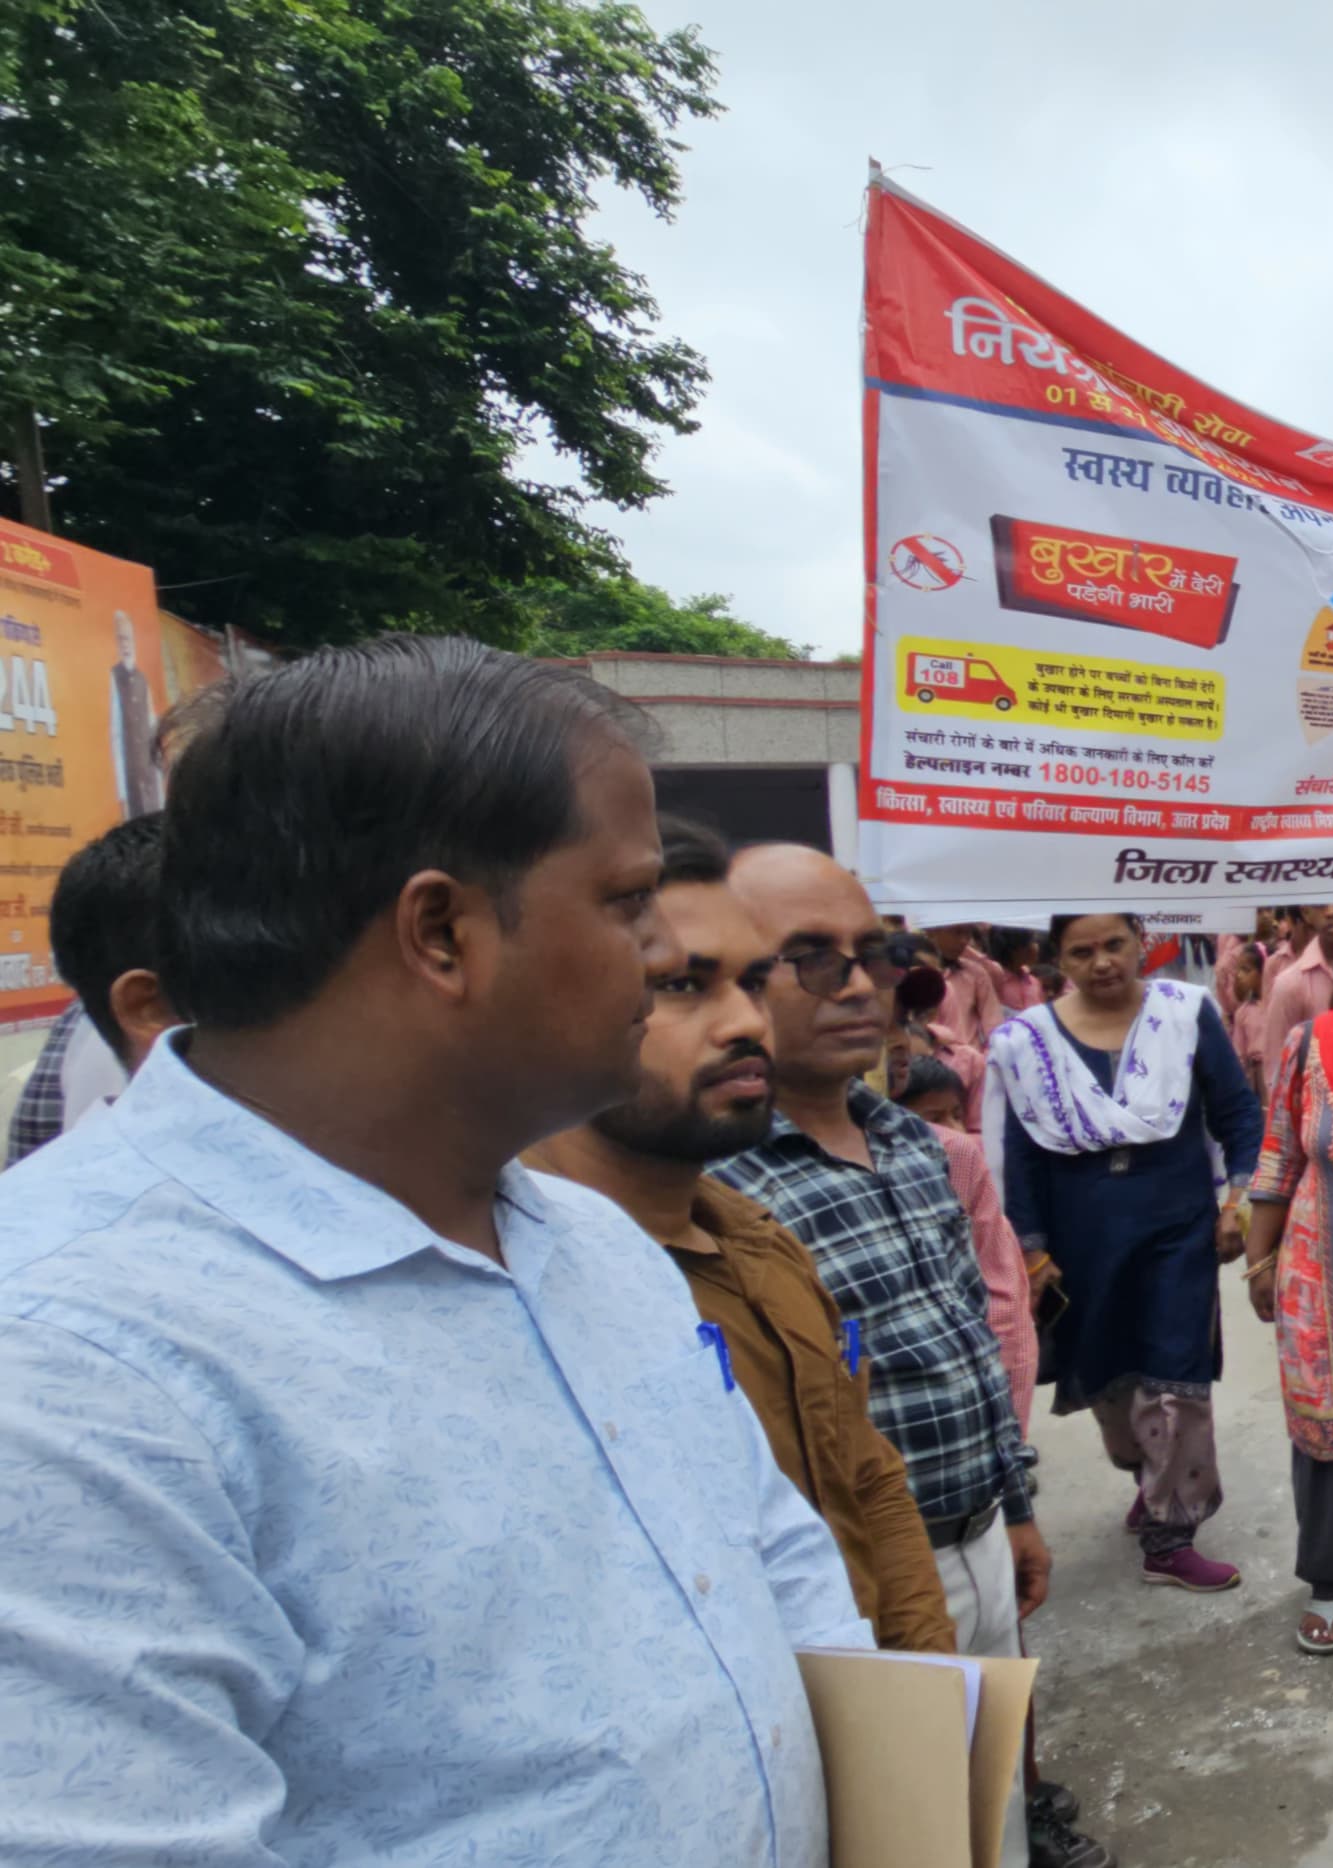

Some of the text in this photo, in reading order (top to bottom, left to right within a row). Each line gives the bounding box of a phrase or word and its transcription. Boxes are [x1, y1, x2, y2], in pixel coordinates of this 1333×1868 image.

[1046, 384, 1077, 407] 01
[1193, 412, 1255, 447] रोग
[1062, 447, 1154, 492] स्वस्थ
[1029, 536, 1225, 596] बुखार में देरी
[1128, 591, 1175, 614] भारी
[920, 668, 959, 685] 108
[930, 659, 952, 670] Call
[1034, 662, 1064, 678] बुखार
[1087, 669, 1101, 679] पर
[1027, 677, 1038, 692] के
[1093, 685, 1114, 704] लिए
[1117, 690, 1151, 705] सरकारी
[1027, 698, 1050, 714] कोई
[1054, 700, 1067, 714] भी
[1071, 704, 1099, 720] बुखार
[1102, 705, 1134, 721] दिमागी
[1137, 711, 1163, 727] बुखार
[905, 729, 1215, 769] संचारी रोगों के बारे में अधिक जानकारी के लिए कॉल करें
[903, 750, 1212, 794] हेल्पलाइन नम्बर 1800-180-5145
[938, 796, 991, 816] स्वास्थ्य
[994, 796, 1018, 818] एवं
[1021, 799, 1067, 821] परिवार
[1069, 806, 1121, 825] कल्याण
[1123, 804, 1167, 830] विभाग,
[1200, 810, 1231, 831] प्रदेश
[1112, 848, 1216, 884] जिला
